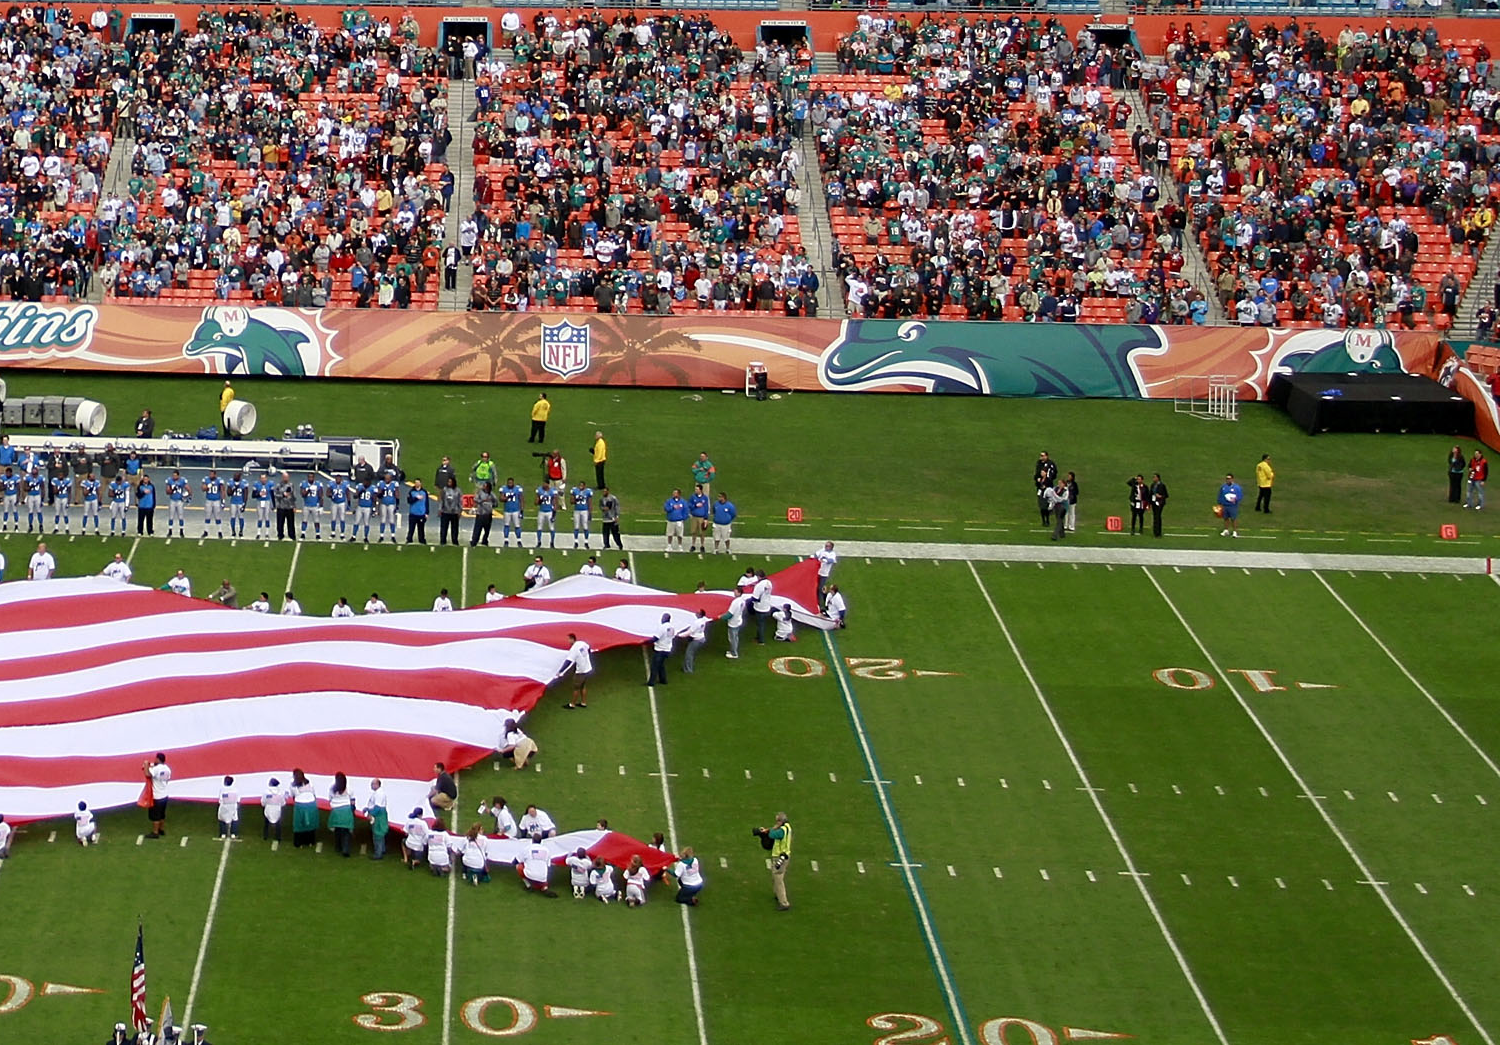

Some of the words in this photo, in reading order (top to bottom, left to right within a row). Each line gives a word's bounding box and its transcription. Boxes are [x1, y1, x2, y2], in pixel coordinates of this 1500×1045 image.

[223, 310, 240, 323] M
[1355, 333, 1373, 348] M
[547, 344, 584, 370] NFL
[789, 509, 800, 520] 20
[1110, 518, 1120, 528] 10
[352, 992, 539, 1036] 30
